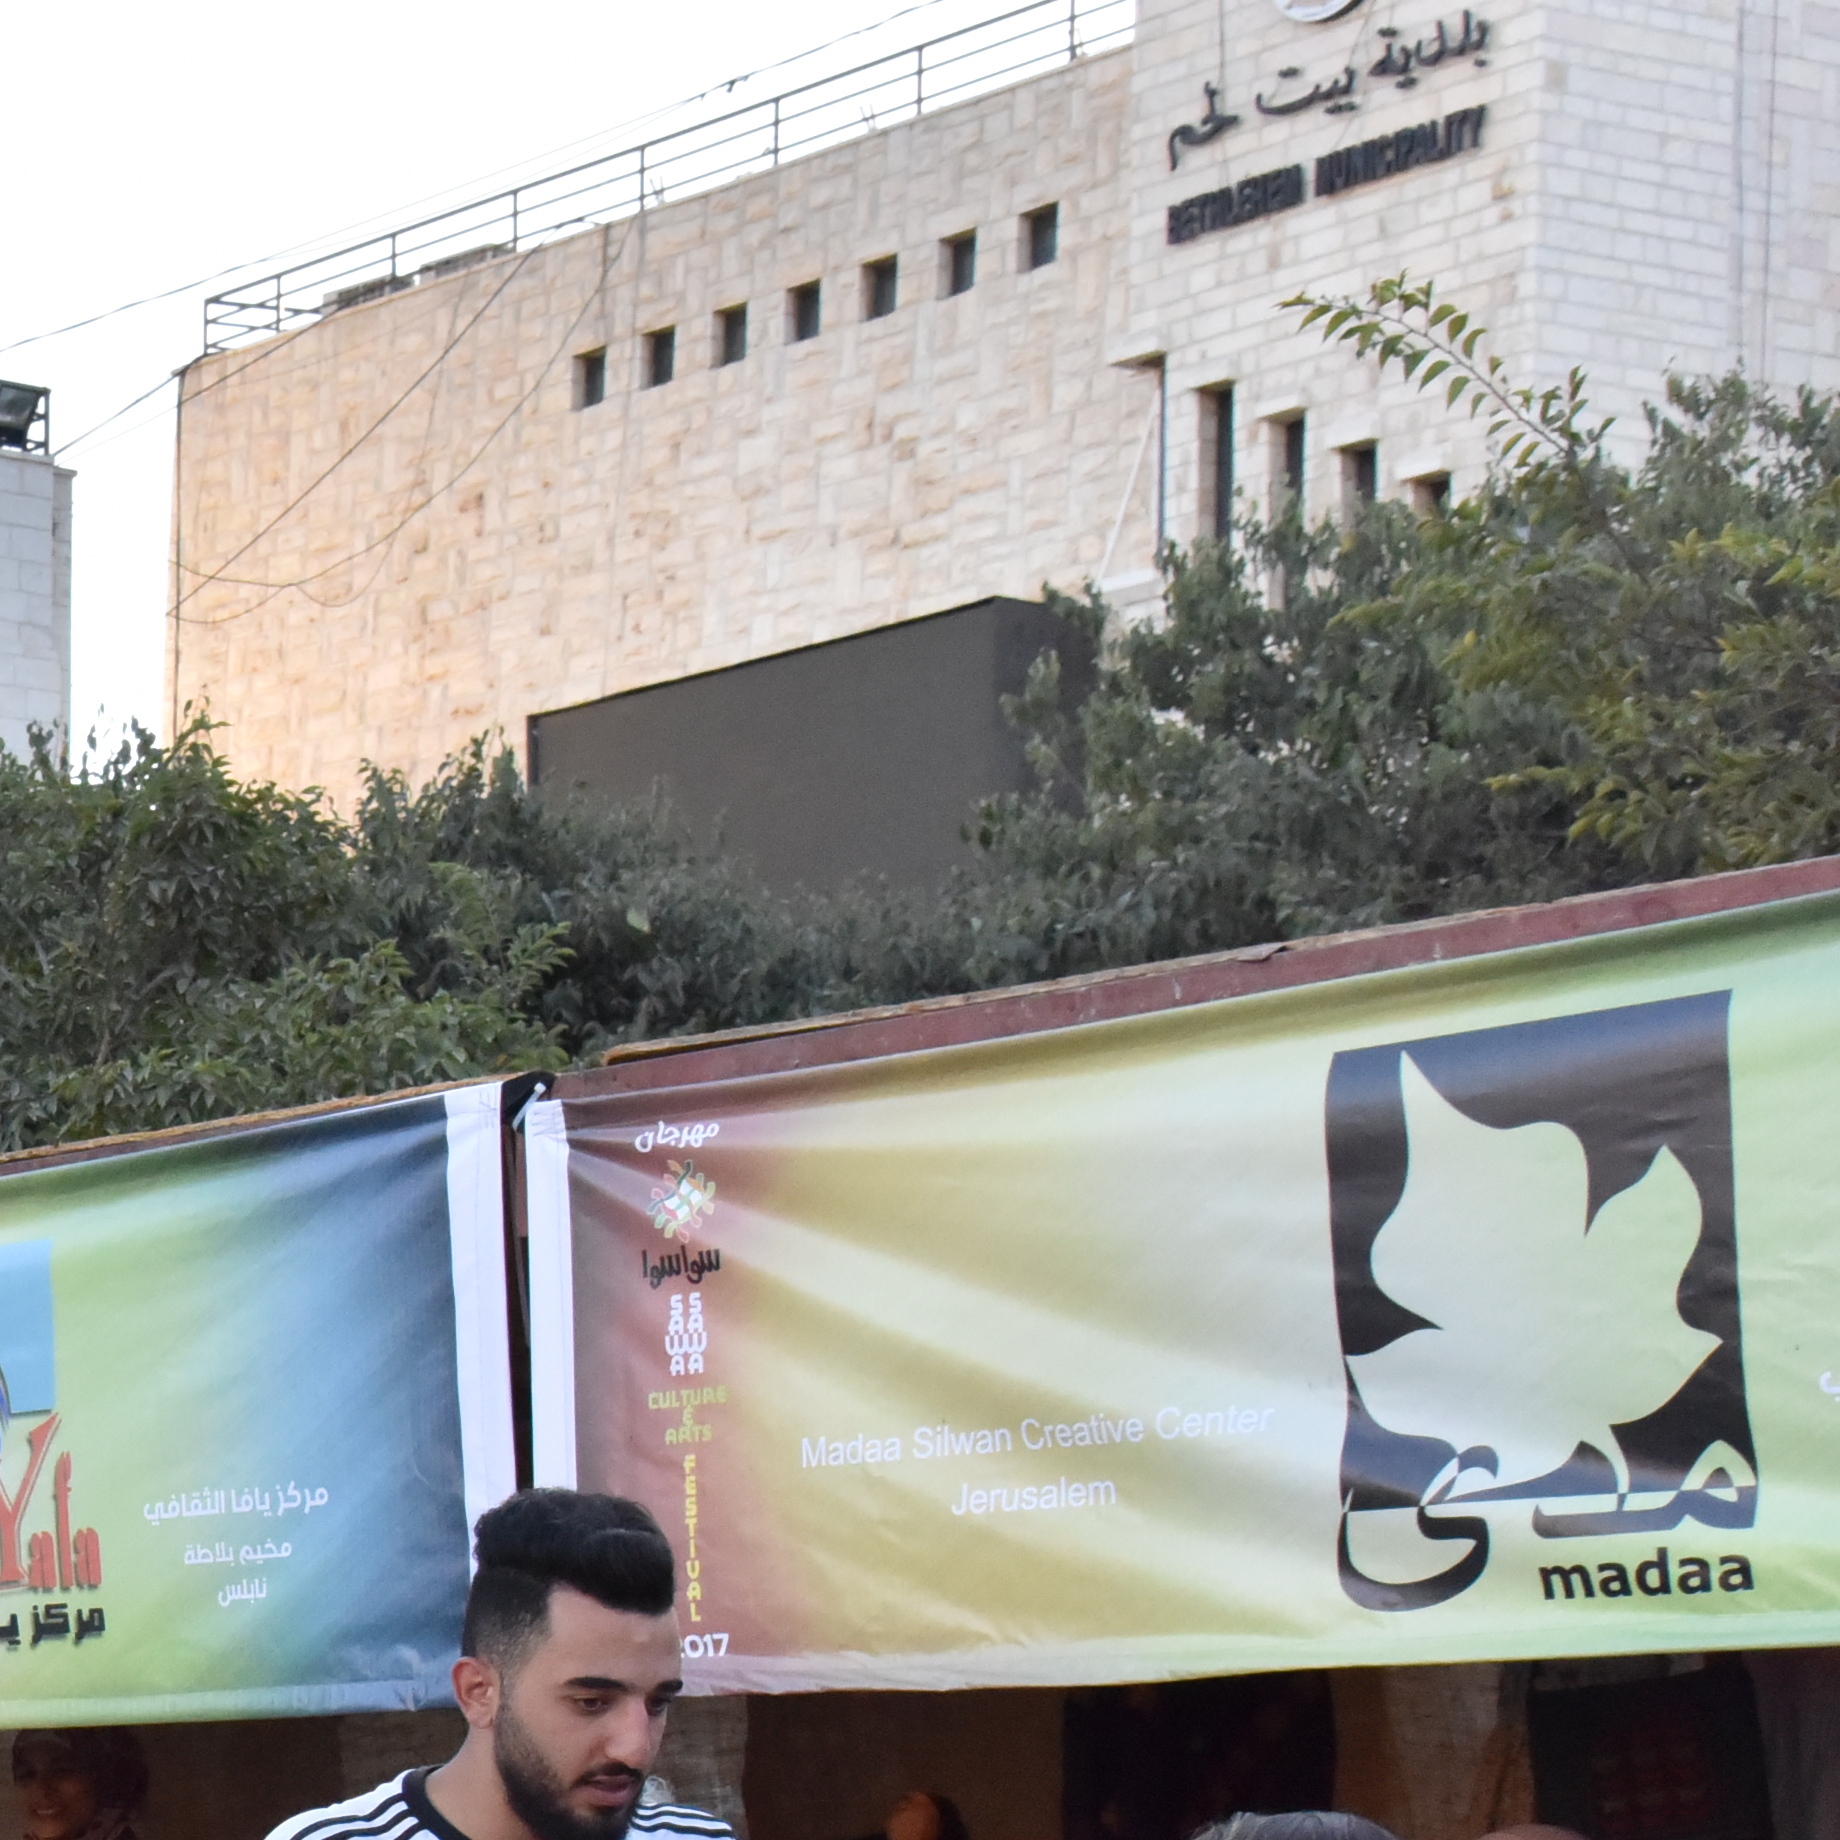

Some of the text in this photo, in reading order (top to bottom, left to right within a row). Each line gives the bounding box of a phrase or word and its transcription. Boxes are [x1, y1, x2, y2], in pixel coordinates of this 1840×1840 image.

[1368, 9, 1490, 89] بلدية
[1255, 65, 1358, 115] بيت
[635, 1120, 720, 1153] مهرجان
[648, 1385, 729, 1409] CULTURE
[665, 1424, 713, 1445] ARTS
[801, 1405, 1274, 1468] Madaa Silwan Creative Center
[143, 1480, 329, 1526] مركز يافا الثقافي
[951, 1477, 1118, 1516] Jerusalem
[184, 1538, 293, 1566] مخيم بلاطة
[218, 1577, 267, 1607] نابلس
[1537, 1546, 1755, 1600] madaa
[31, 1603, 106, 1645] مركز
[681, 1633, 730, 1659] 017
